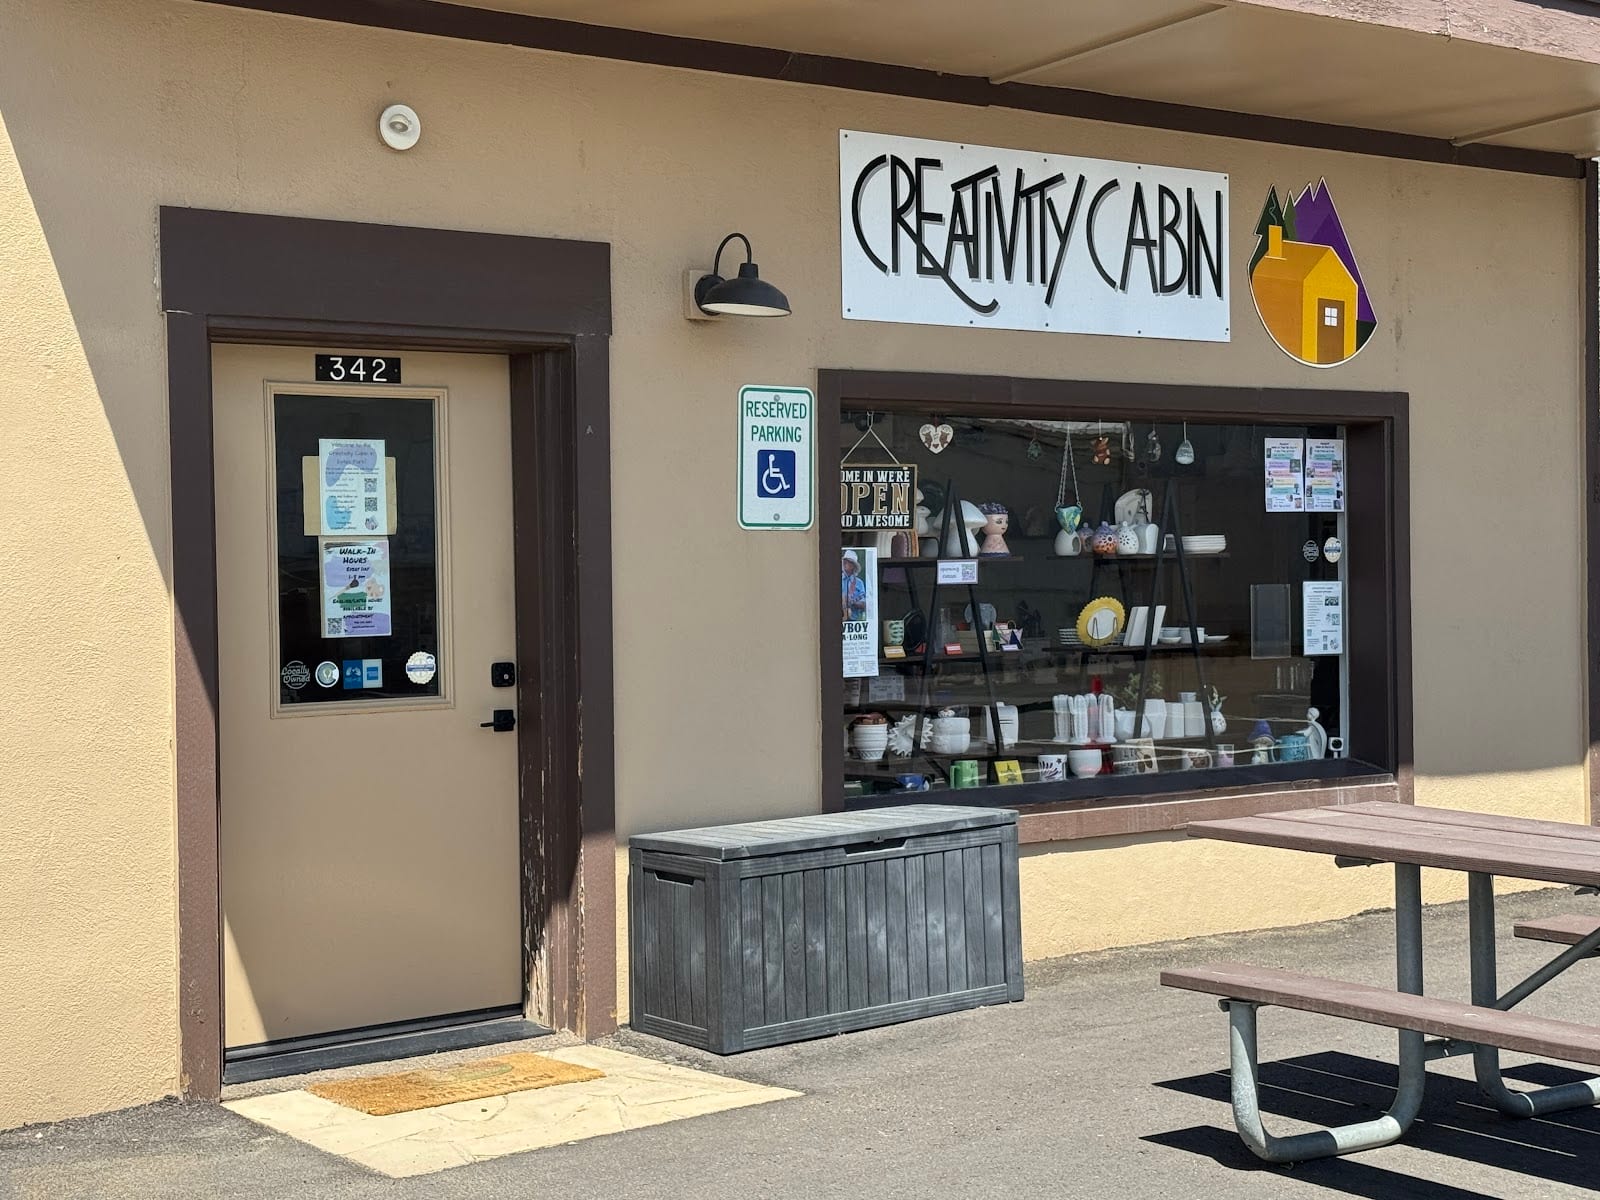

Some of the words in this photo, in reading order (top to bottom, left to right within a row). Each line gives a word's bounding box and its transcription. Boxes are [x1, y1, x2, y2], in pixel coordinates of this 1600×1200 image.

[851, 153, 1086, 315] CREATIVITY
[1086, 178, 1223, 300] CABIN
[329, 357, 388, 382] 342
[745, 400, 807, 420] RESERVED
[751, 425, 802, 443] PARKING
[841, 470, 860, 483] OME
[863, 470, 874, 483] IN
[877, 470, 910, 483] WE'RE
[841, 515, 853, 527] ND
[855, 515, 910, 527] AWESOME
[339, 547, 377, 555] WALK-IN
[842, 622, 869, 633] BOY
